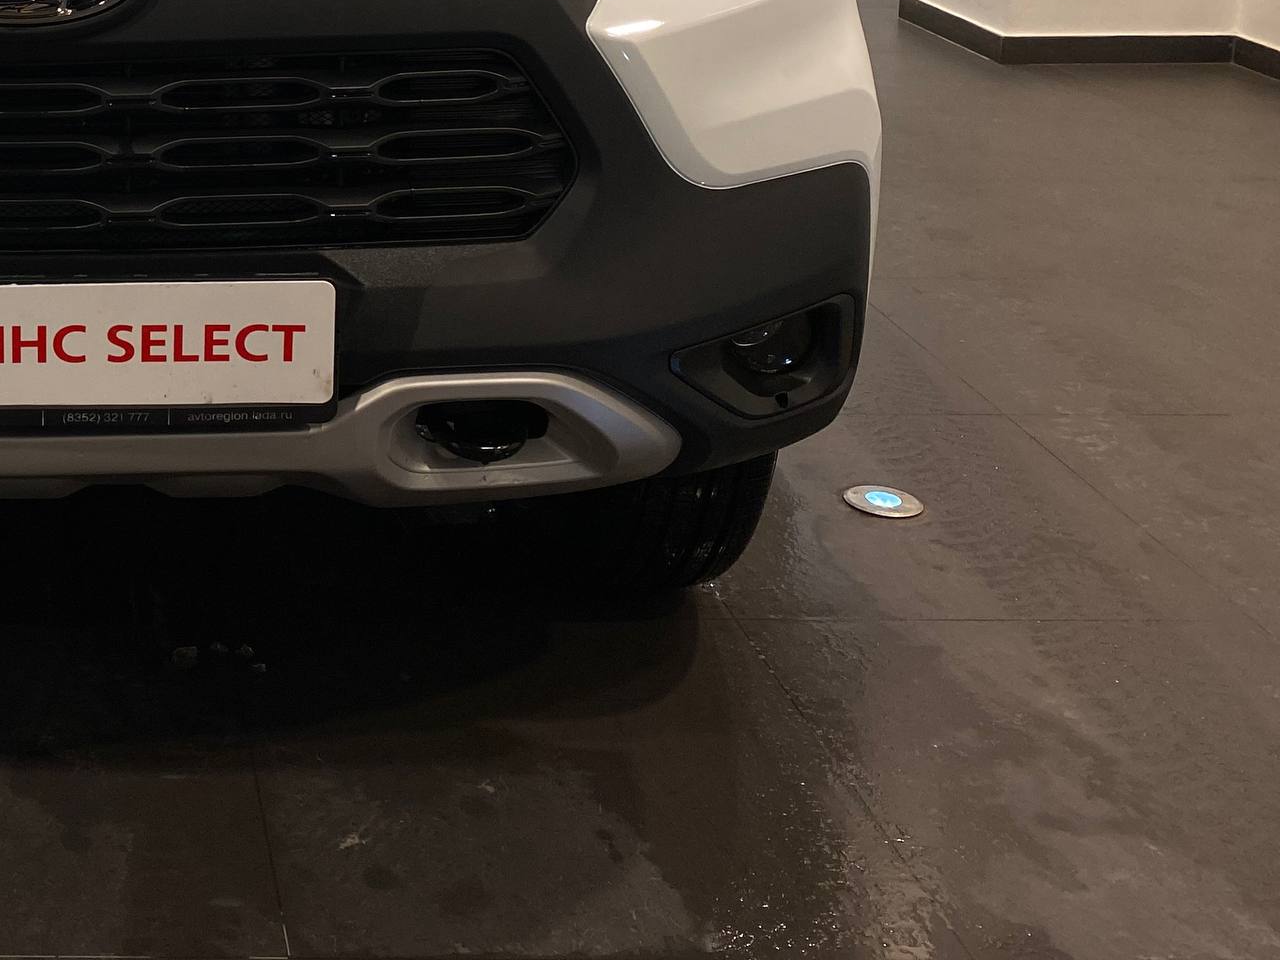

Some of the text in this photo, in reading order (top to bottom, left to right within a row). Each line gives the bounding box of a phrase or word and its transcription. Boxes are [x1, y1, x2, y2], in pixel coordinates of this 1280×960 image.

[107, 323, 307, 364] SELECT
[62, 411, 150, 424] (8352) 321 777
